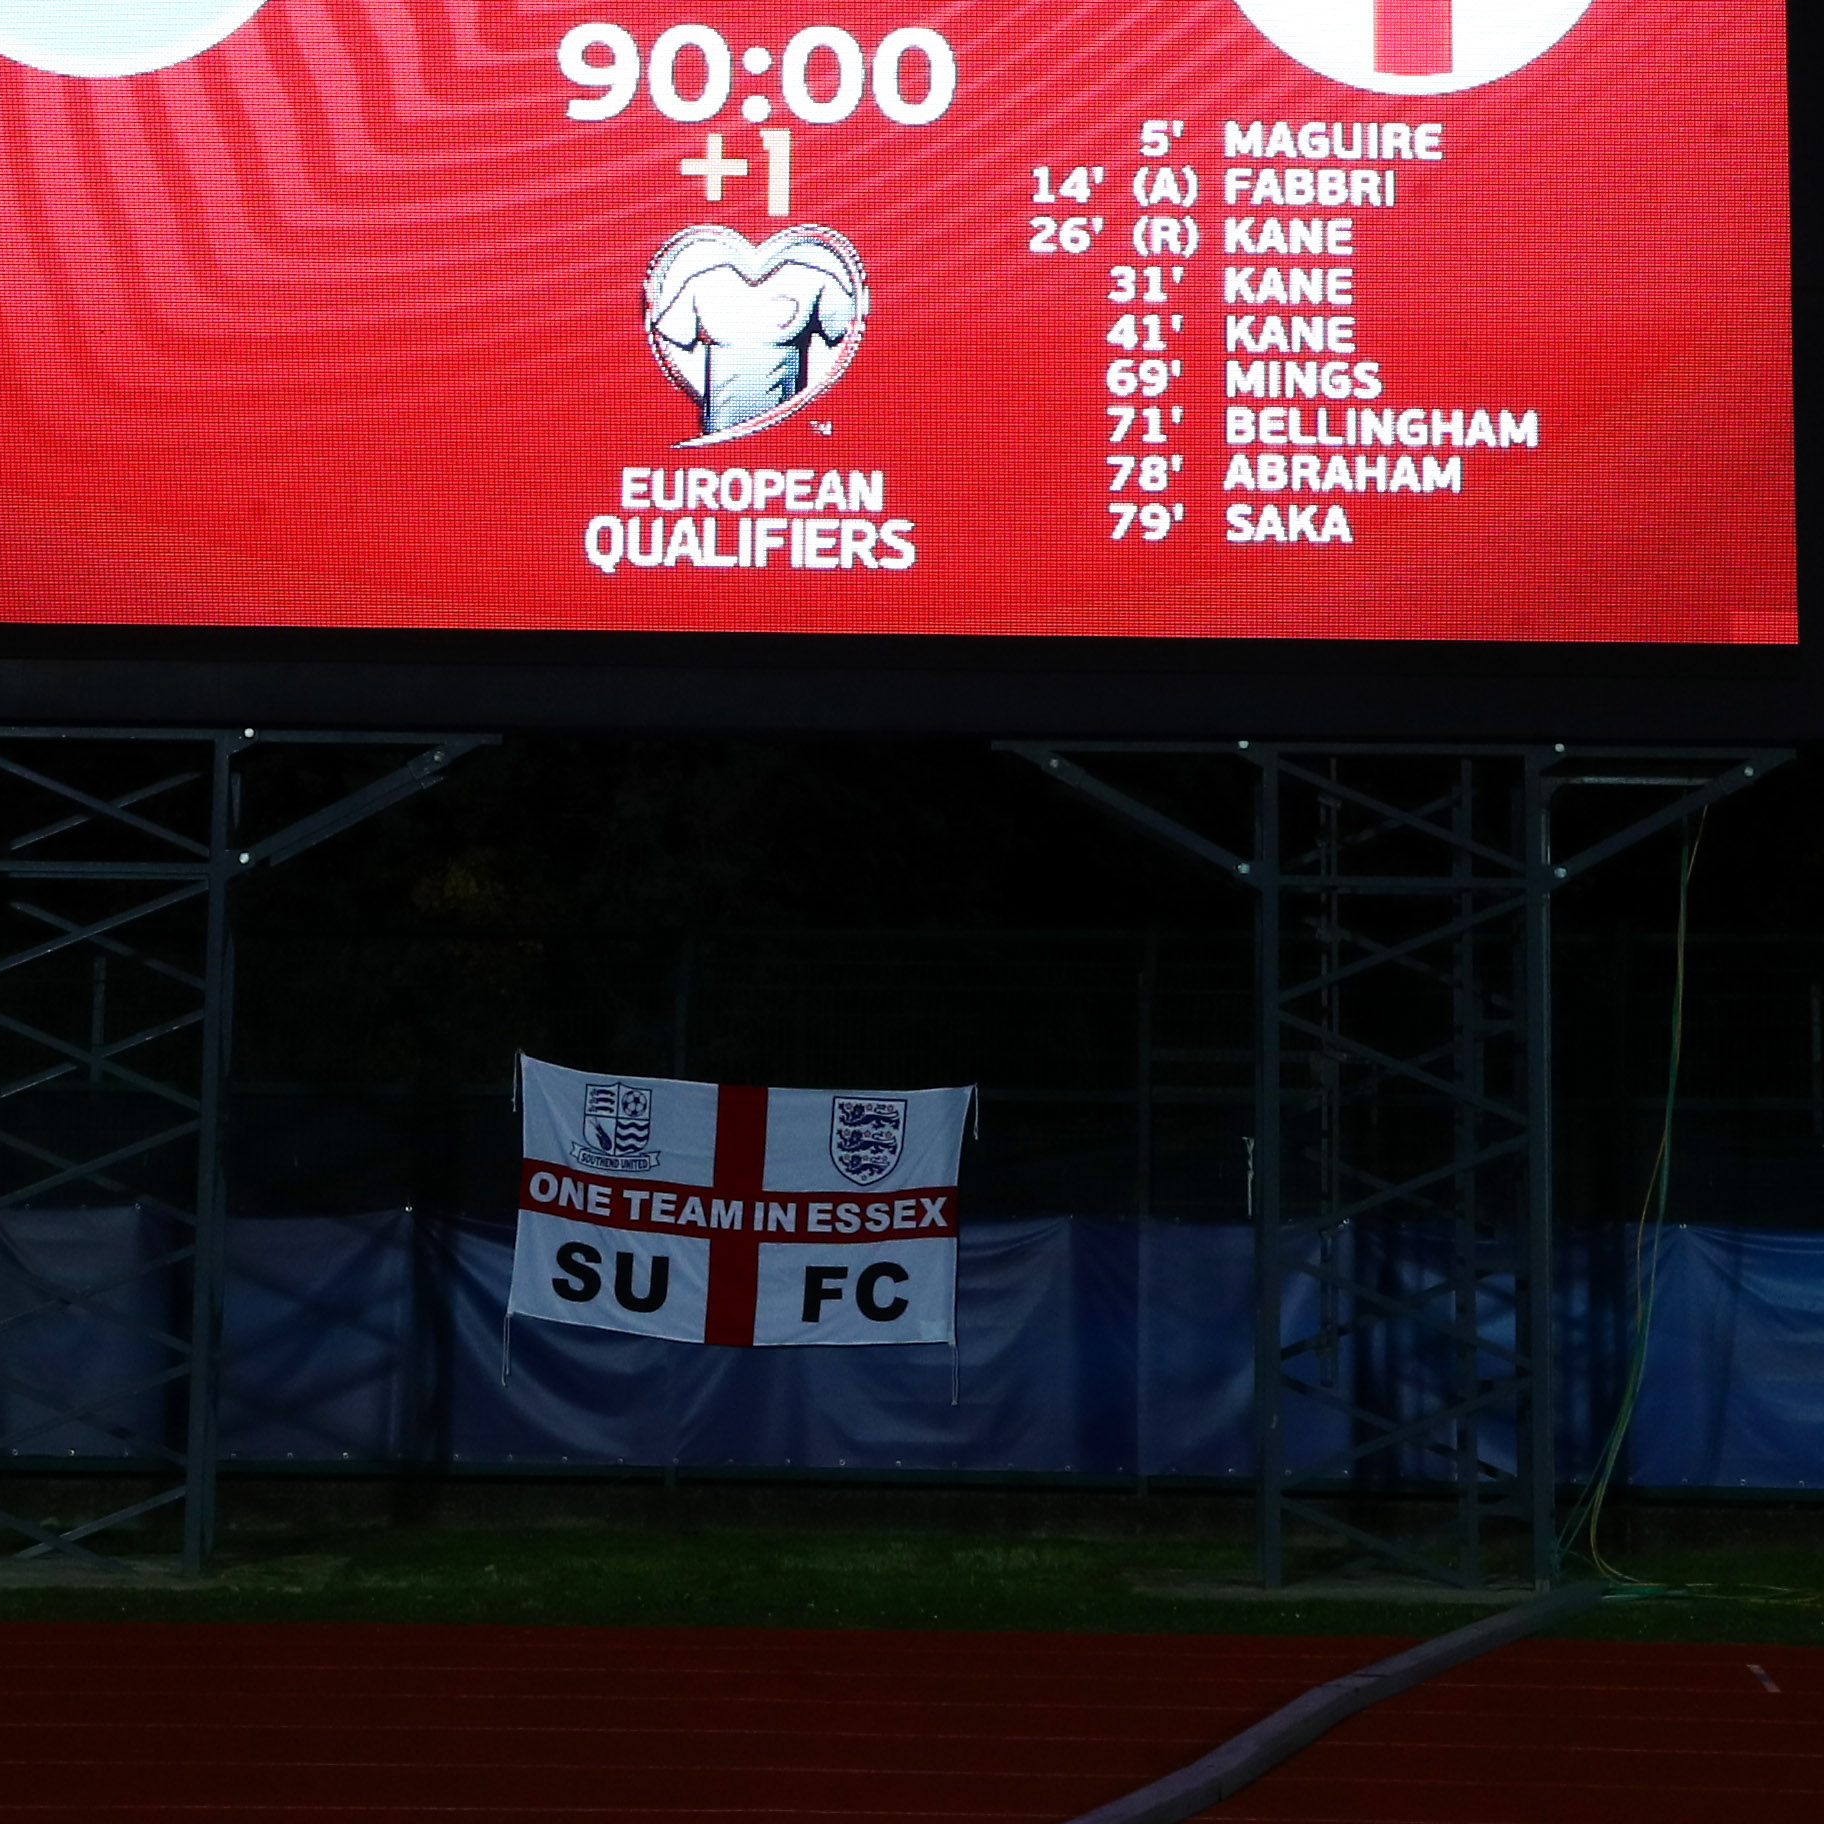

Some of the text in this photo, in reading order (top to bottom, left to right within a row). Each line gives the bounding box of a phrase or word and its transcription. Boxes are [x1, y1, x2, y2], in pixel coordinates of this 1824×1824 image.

[555, 21, 958, 127] 90:00
[1138, 118, 1444, 162] 5' MAGUIRE
[679, 127, 793, 218] +1
[1031, 164, 1396, 209] 14' (A) FABBRI
[1028, 214, 1355, 260] 26' (R) KANE
[1106, 264, 1354, 307] 31' KANE
[1105, 313, 1357, 355] 41' KANE
[1105, 357, 1384, 401] 69' MINGS
[1106, 404, 1540, 449] 71' BELLINGHAM
[620, 466, 885, 513] EUROPEAN
[1105, 452, 1463, 494] 78' ABRAHAM
[583, 514, 917, 575] QUALIFIERS
[1107, 501, 1355, 544] 79' SAKA
[581, 1152, 648, 1169] SOUTHEND UNITED
[528, 1171, 949, 1233] ONE TEAM IN ESSEX
[552, 1241, 910, 1323] SU FC
